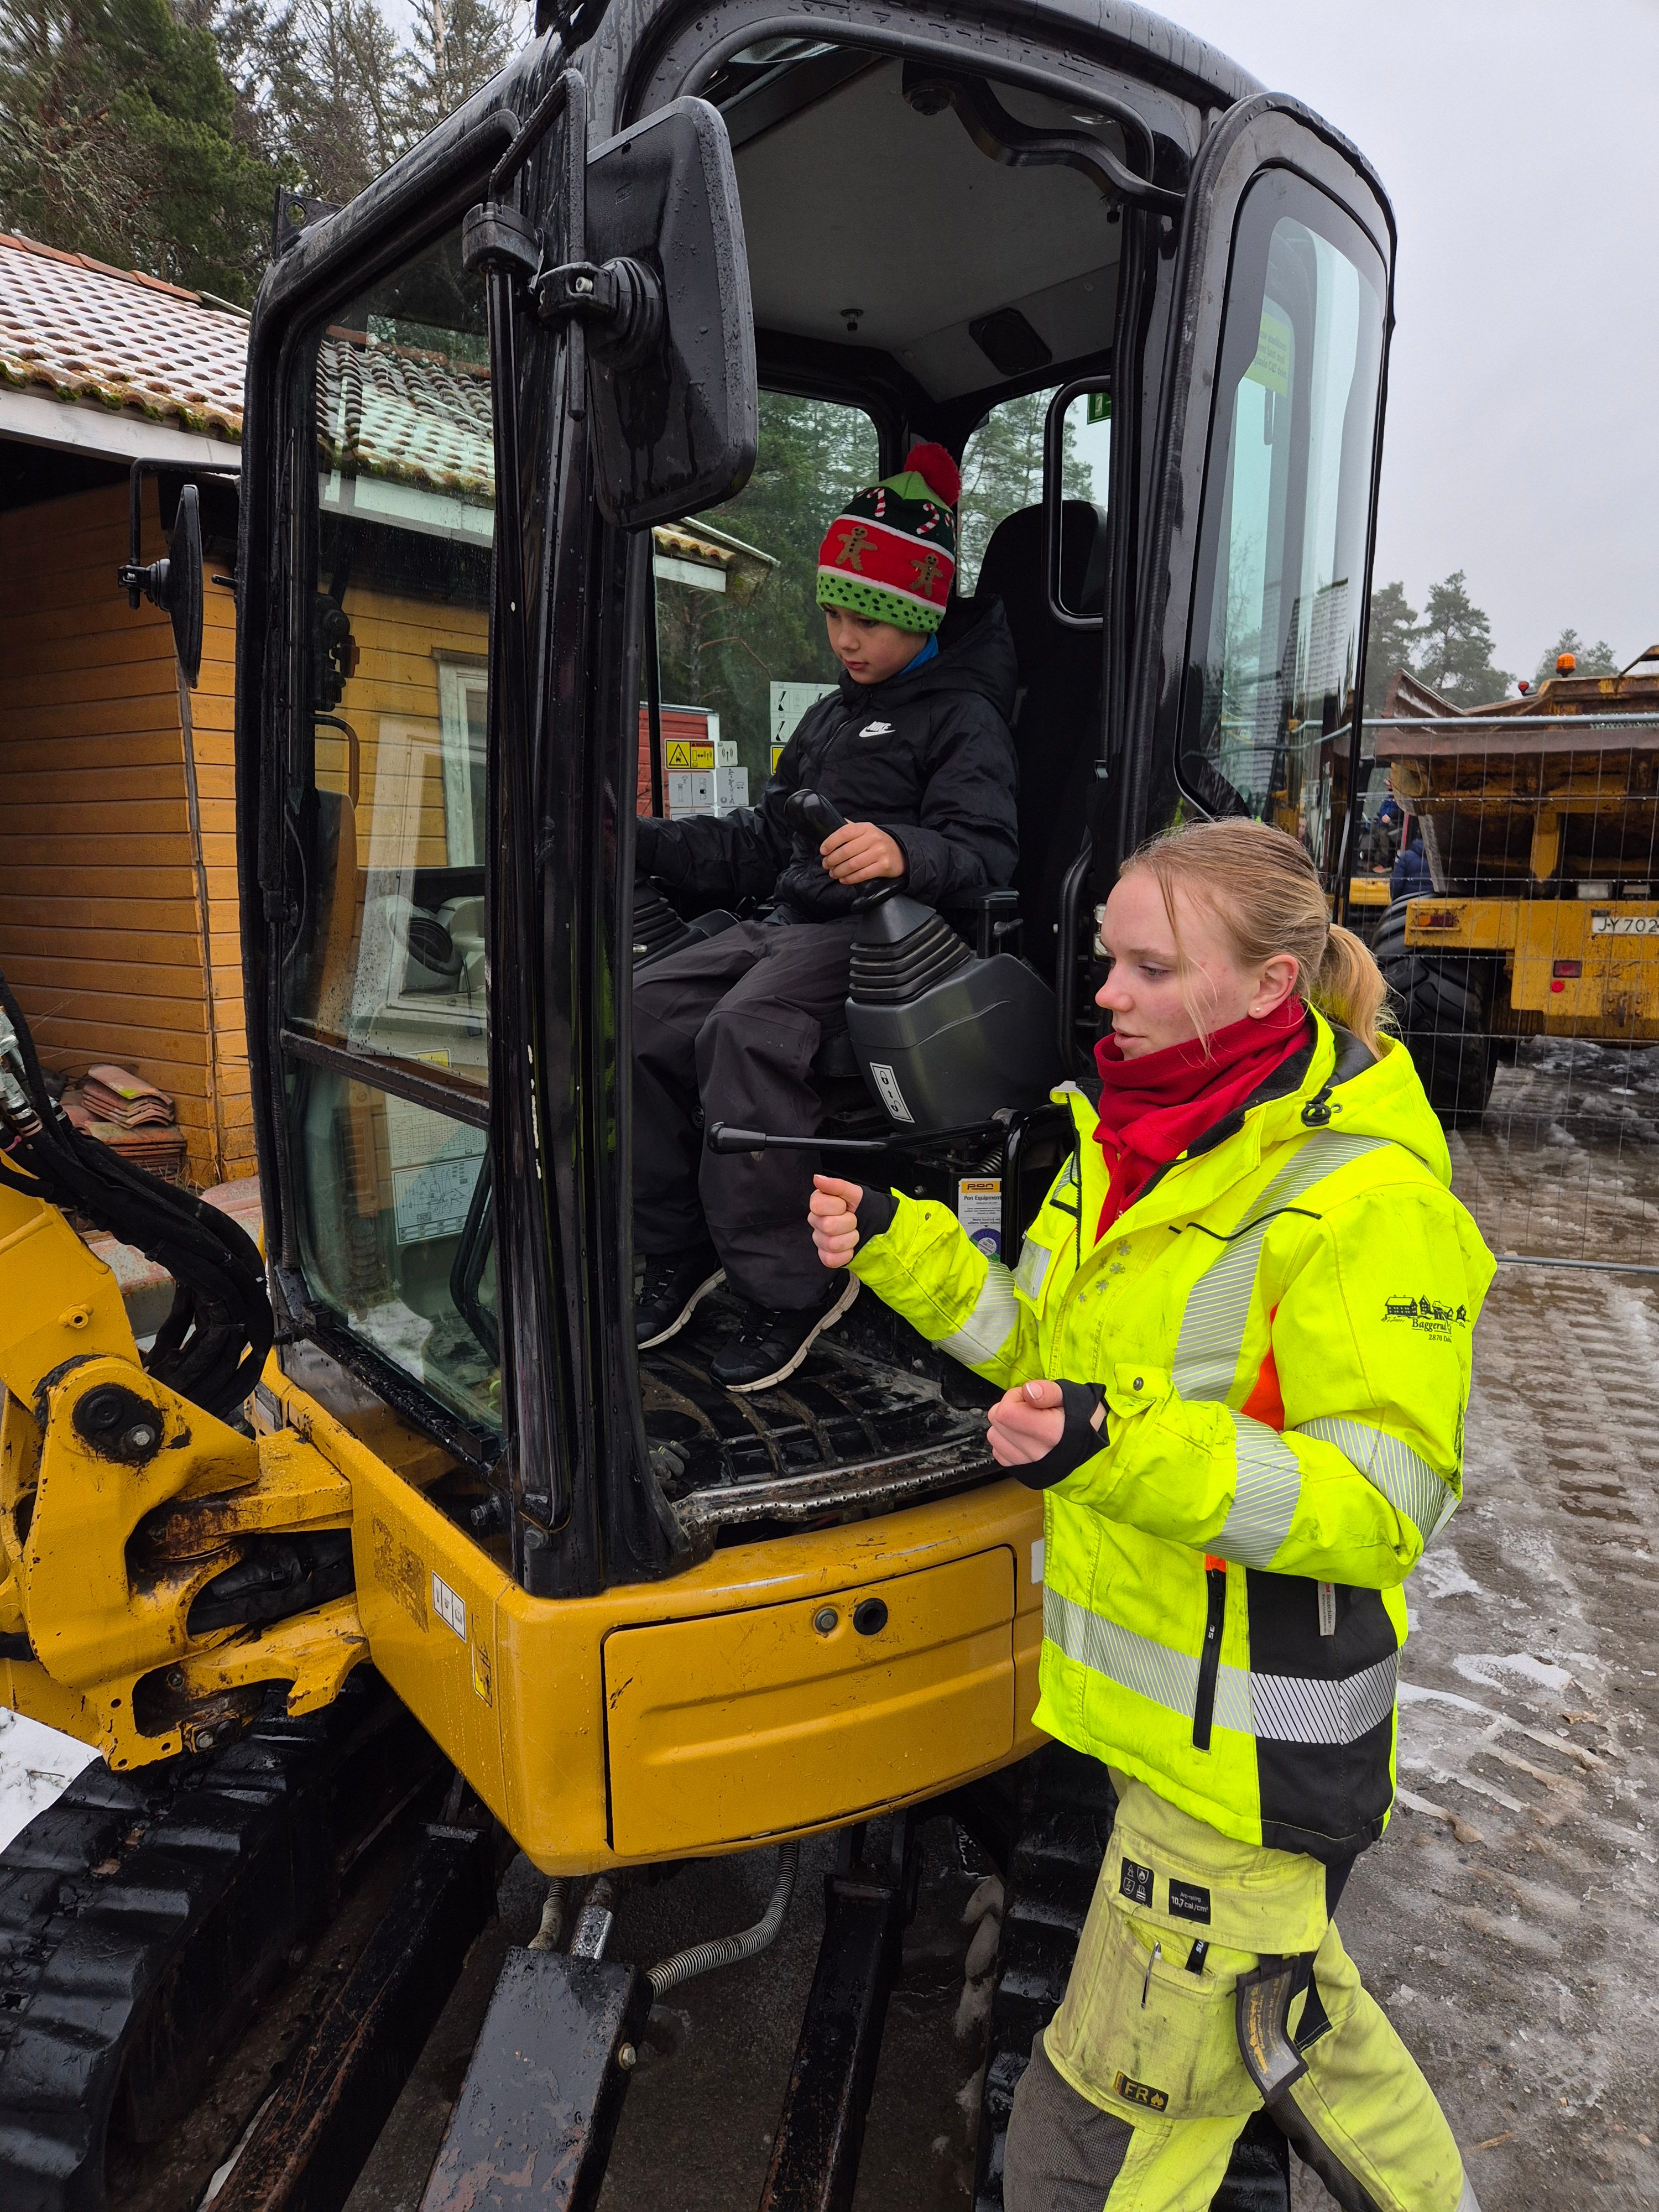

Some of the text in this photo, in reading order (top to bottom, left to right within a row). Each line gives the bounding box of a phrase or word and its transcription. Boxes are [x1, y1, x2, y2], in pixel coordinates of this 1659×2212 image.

[867, 721, 891, 731] NIKE
[1598, 919, 1620, 932] JY
[1180, 1891, 1201, 1903] Arc-rating
[1125, 2081, 1149, 2103] FR
